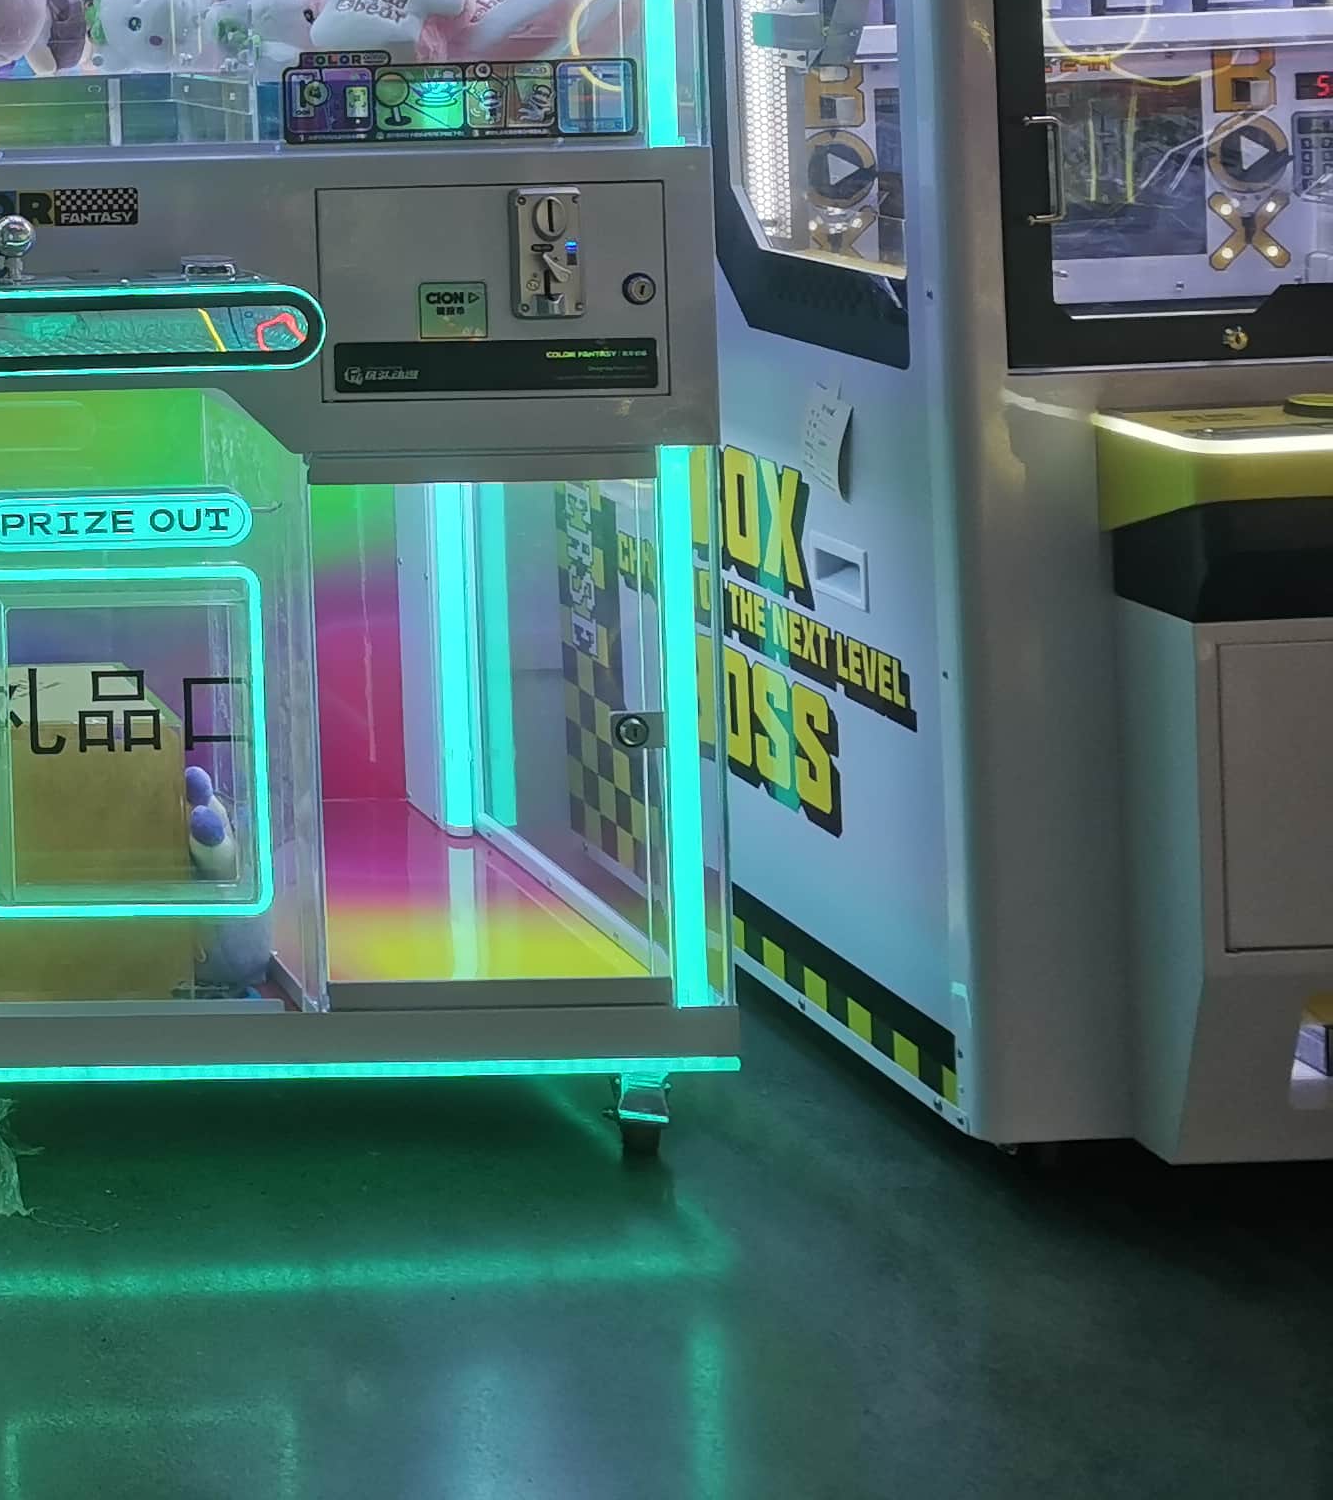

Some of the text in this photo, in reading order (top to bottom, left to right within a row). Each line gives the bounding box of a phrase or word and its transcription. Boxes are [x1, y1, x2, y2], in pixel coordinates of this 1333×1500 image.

[60, 211, 133, 225] FANTASY
[425, 291, 465, 305] CION
[0, 506, 231, 537] PRIZE OUT
[728, 581, 767, 636] THE
[772, 601, 831, 670] NEXT
[834, 631, 907, 709] LEVEL
